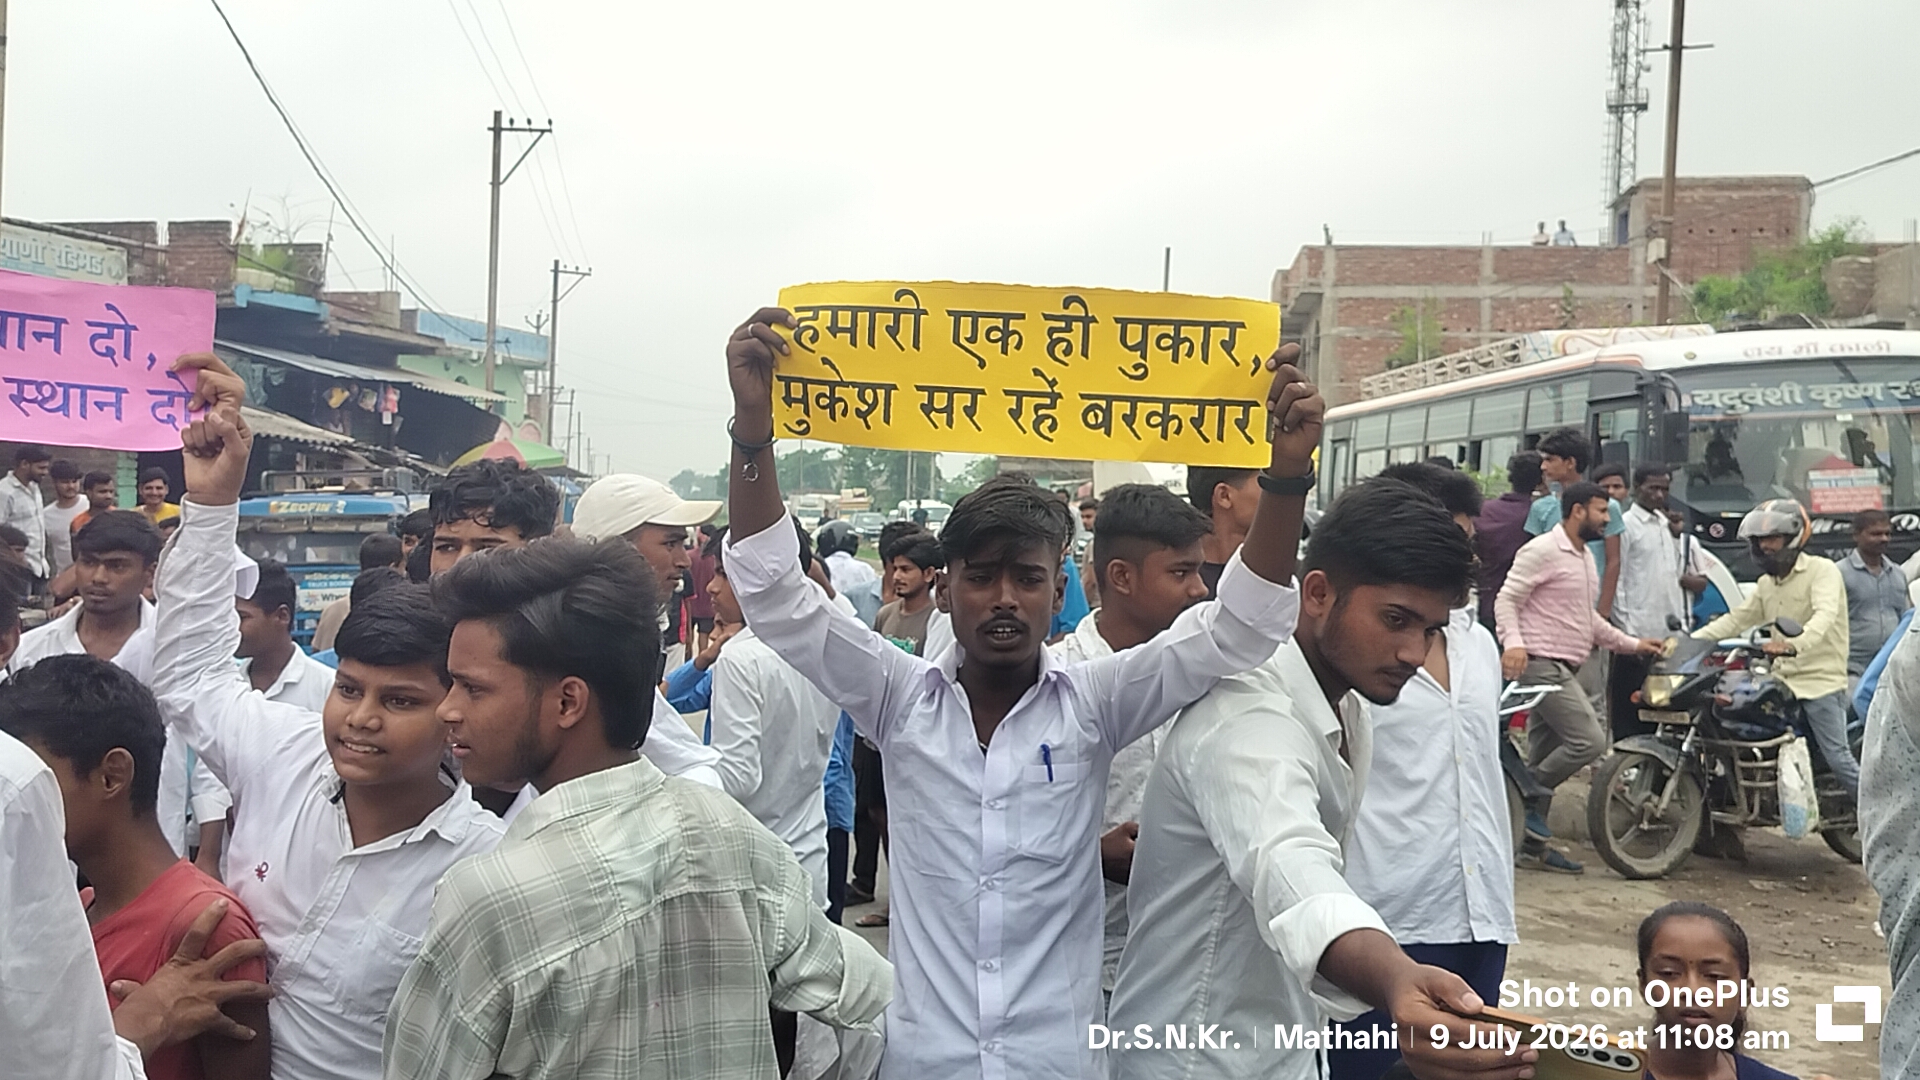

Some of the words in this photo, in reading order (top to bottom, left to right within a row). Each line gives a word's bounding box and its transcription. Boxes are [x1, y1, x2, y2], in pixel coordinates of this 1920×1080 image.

[85, 303, 157, 371] दो,
[794, 288, 928, 353] हमारी
[945, 309, 1026, 370] एक
[1041, 295, 1099, 366] ही
[1113, 316, 1262, 381] पुकार,
[2, 377, 130, 422] स्थान
[146, 370, 211, 432] दो
[775, 356, 899, 435] मुकेश
[914, 385, 987, 432] सर
[1002, 368, 1064, 442] रहें
[1691, 381, 1804, 414] यदुवंशी
[1807, 382, 1885, 409] कृष्ण
